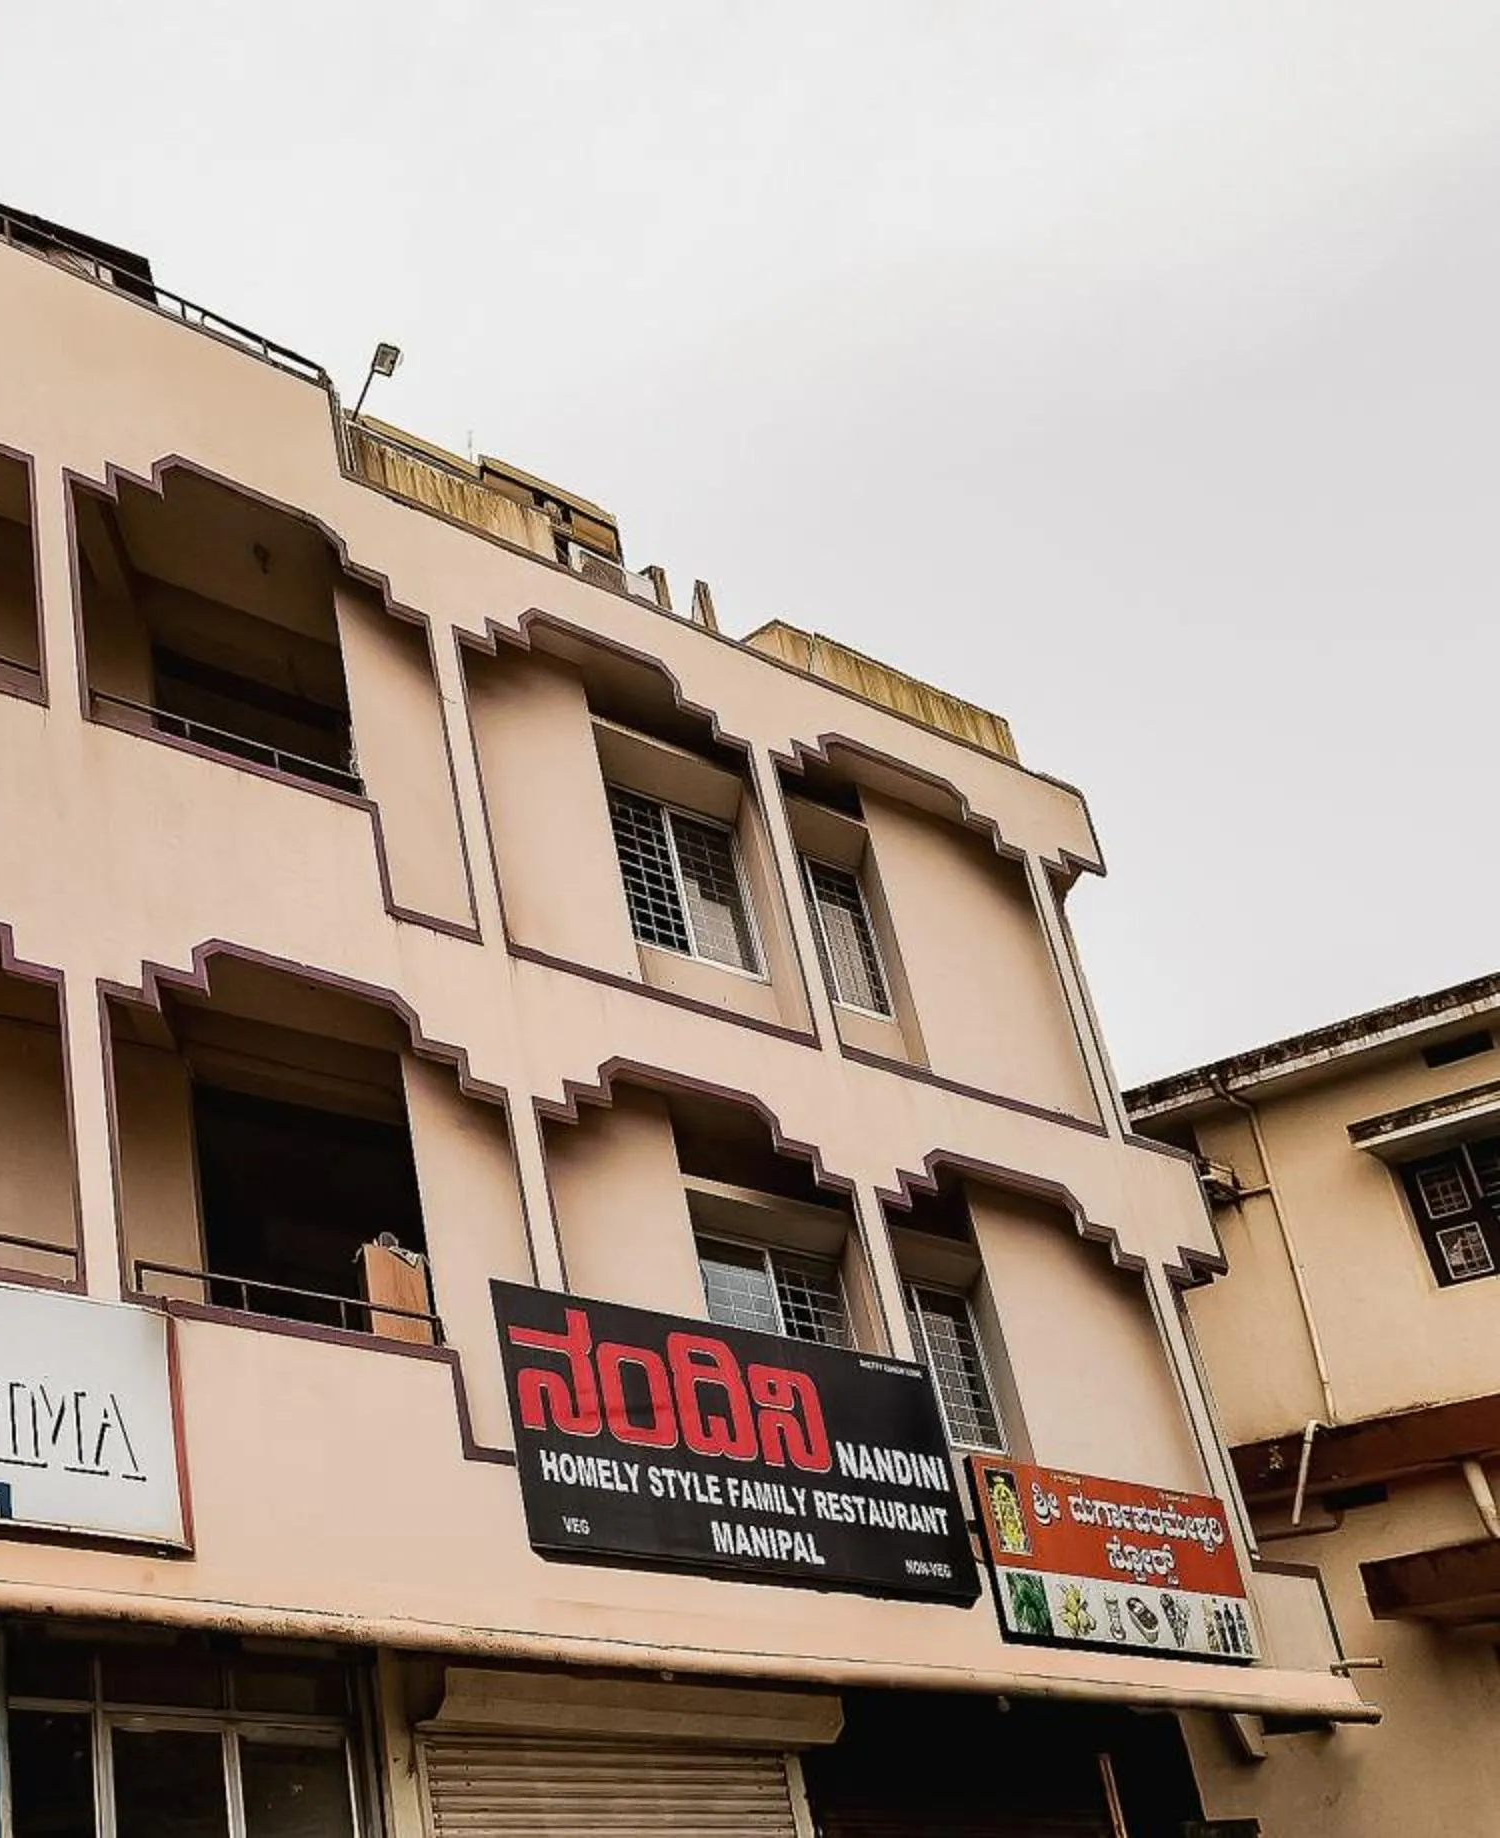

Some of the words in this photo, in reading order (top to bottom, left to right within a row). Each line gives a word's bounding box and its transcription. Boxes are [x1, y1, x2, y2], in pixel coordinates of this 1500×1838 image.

[507, 1307, 833, 1474] ನಂದಿನಿ
[835, 1440, 951, 1493] NANDINI
[539, 1448, 640, 1495] HOMELY
[647, 1466, 723, 1506] STYLE
[727, 1476, 812, 1519] FAMILY
[814, 1491, 950, 1537] RESTAURANT
[1031, 1481, 1060, 1525] ಶ್ರೀ
[561, 1515, 591, 1536] VEG
[710, 1520, 826, 1566] MANIPAL
